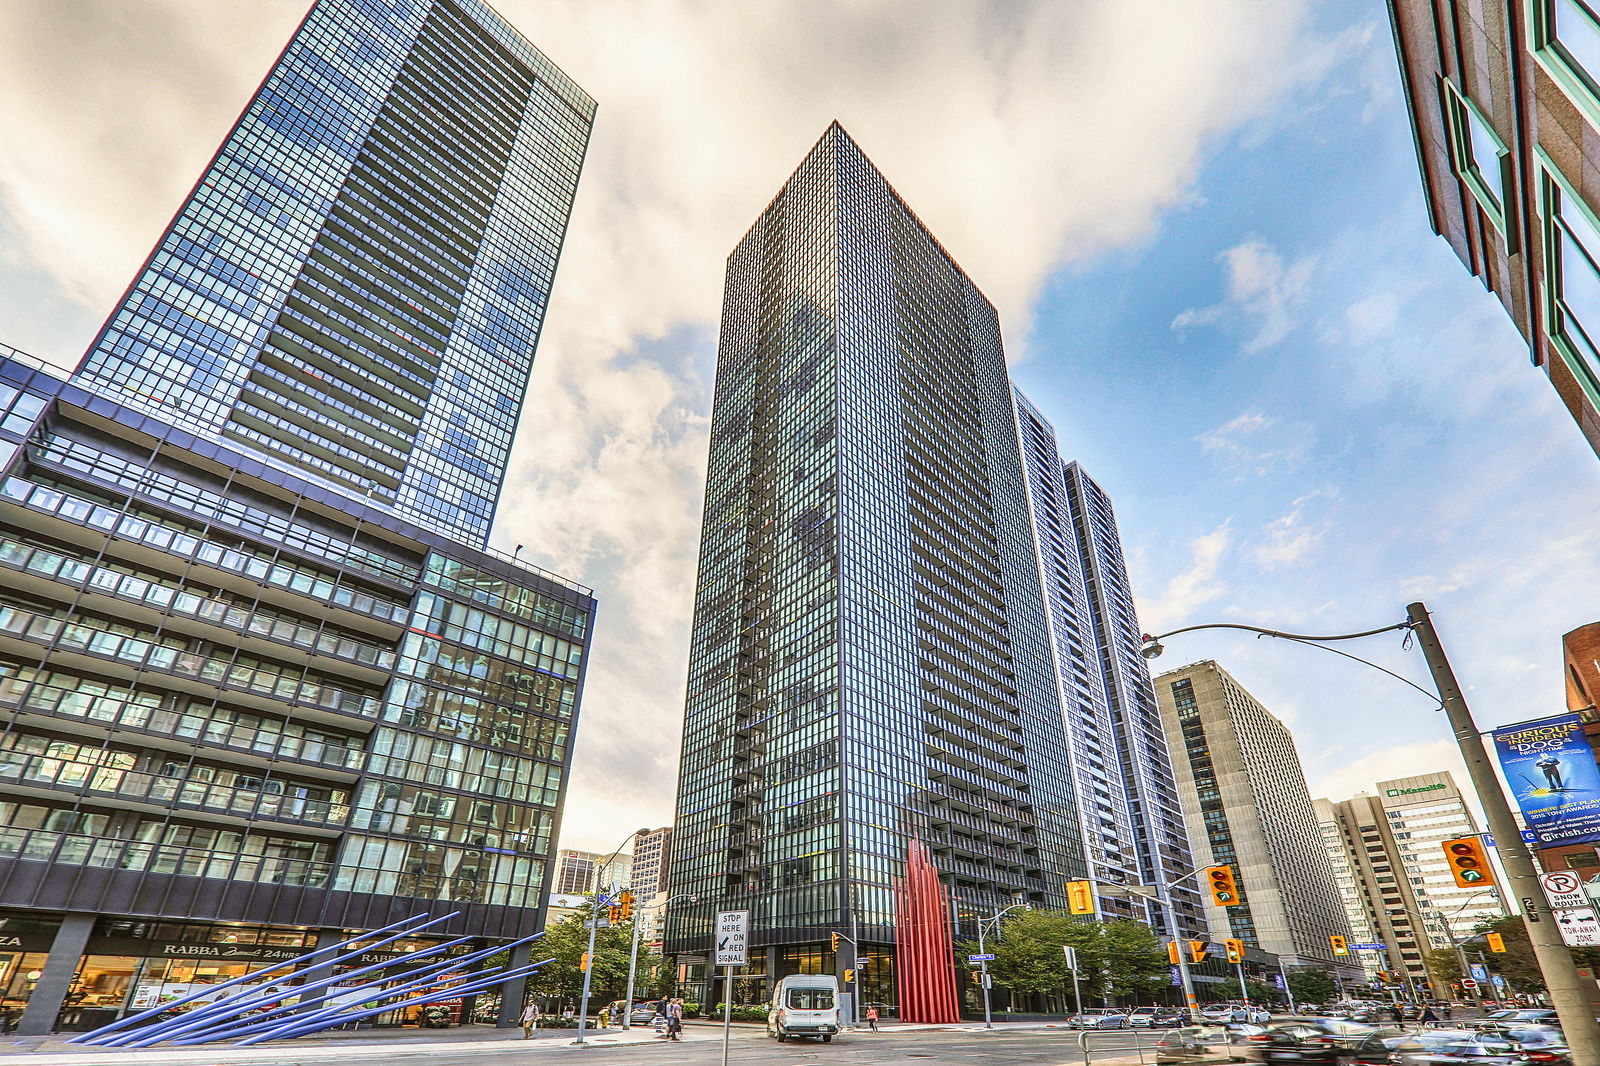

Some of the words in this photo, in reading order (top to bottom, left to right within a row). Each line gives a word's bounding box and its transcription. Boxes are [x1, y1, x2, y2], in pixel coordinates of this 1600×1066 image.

[1496, 723, 1580, 742] CURIOUS
[1508, 731, 1571, 745] INCIDENT
[1518, 739, 1564, 752] DOG
[1547, 809, 1565, 817] TONY
[1566, 803, 1599, 813] AWARDS
[1554, 893, 1580, 901] SNOW
[1555, 899, 1586, 907] ROUTE
[723, 914, 742, 923] STOP
[722, 924, 741, 932] HERE
[1563, 925, 1597, 935] TOW-AWAY
[1575, 934, 1594, 943] ZONE
[163, 944, 220, 956] RABBA
[729, 944, 744, 952] RED
[718, 954, 743, 963] SIGNAL
